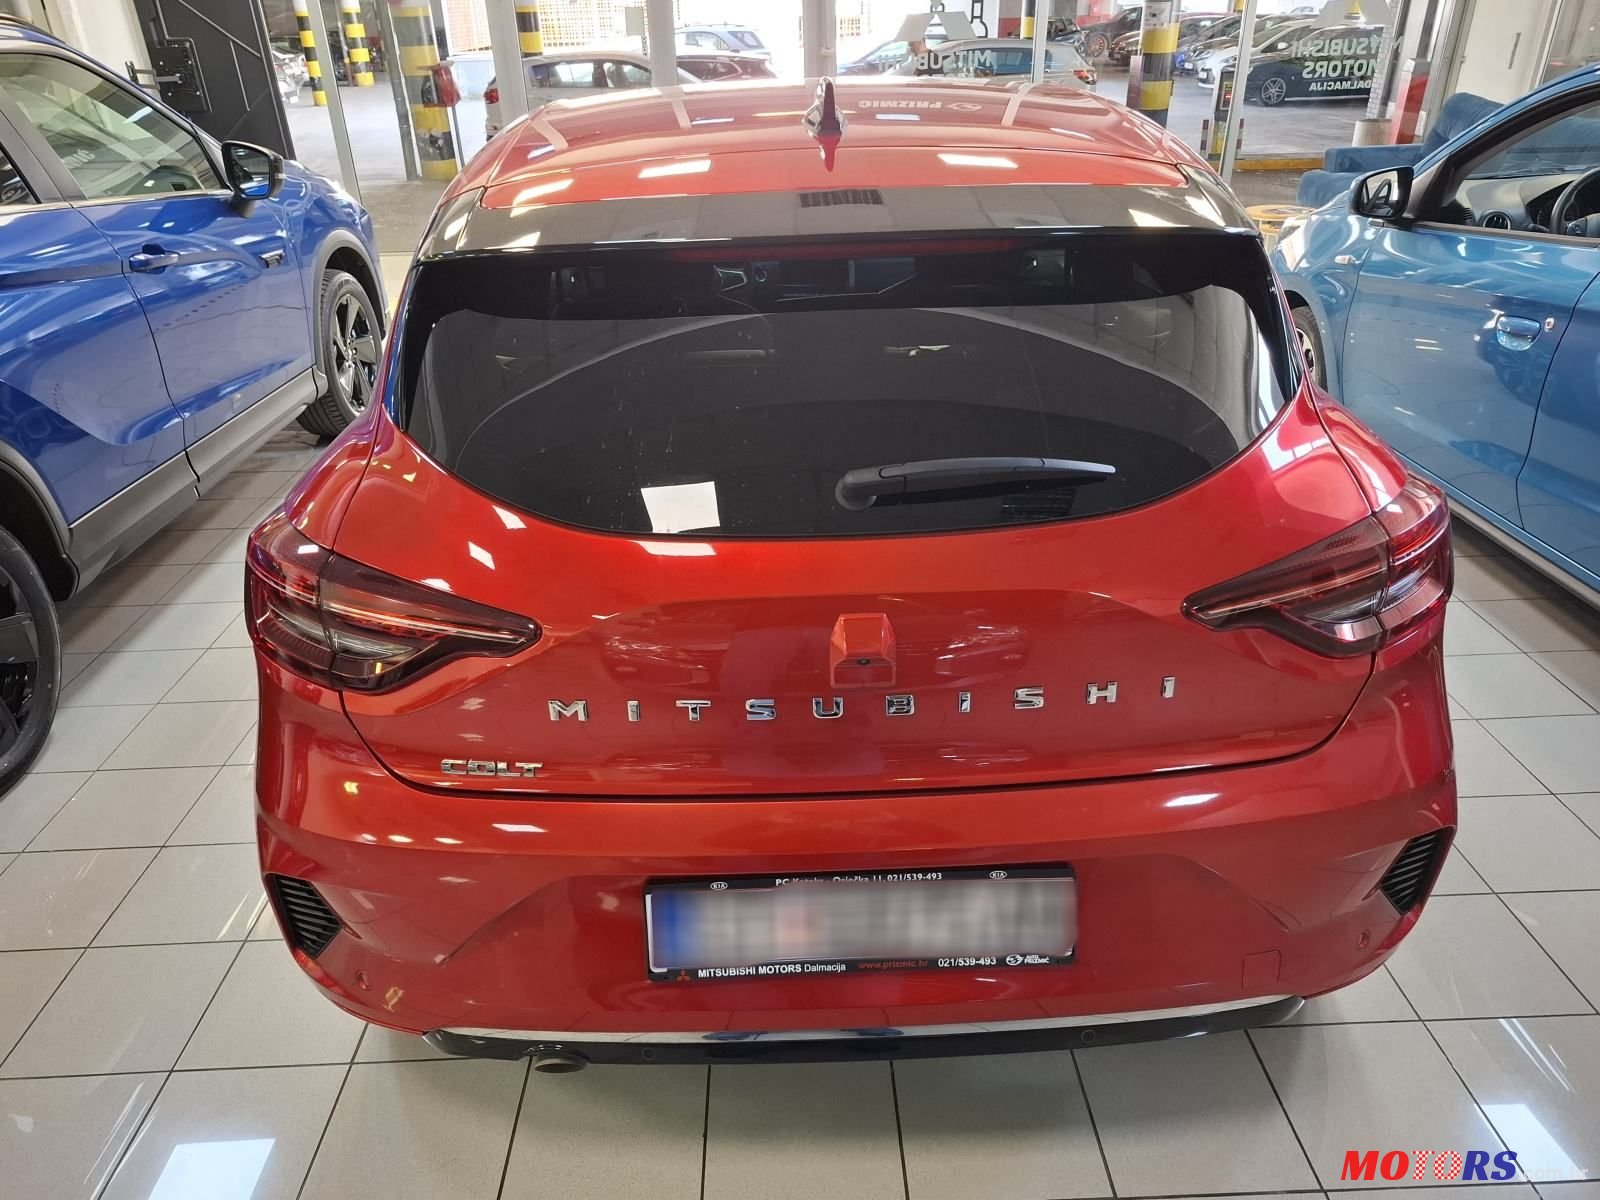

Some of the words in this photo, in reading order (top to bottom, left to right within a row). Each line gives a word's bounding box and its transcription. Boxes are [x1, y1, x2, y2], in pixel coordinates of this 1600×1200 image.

[547, 676, 1176, 722] MITSUBISHI
[440, 759, 544, 778] COLT
[887, 872, 942, 882] 021/539-493
[938, 956, 997, 967] 021/539-493
[698, 966, 756, 978] MITSUBISHI
[758, 964, 802, 975] MOTORS
[804, 962, 846, 974] Dalmacija
